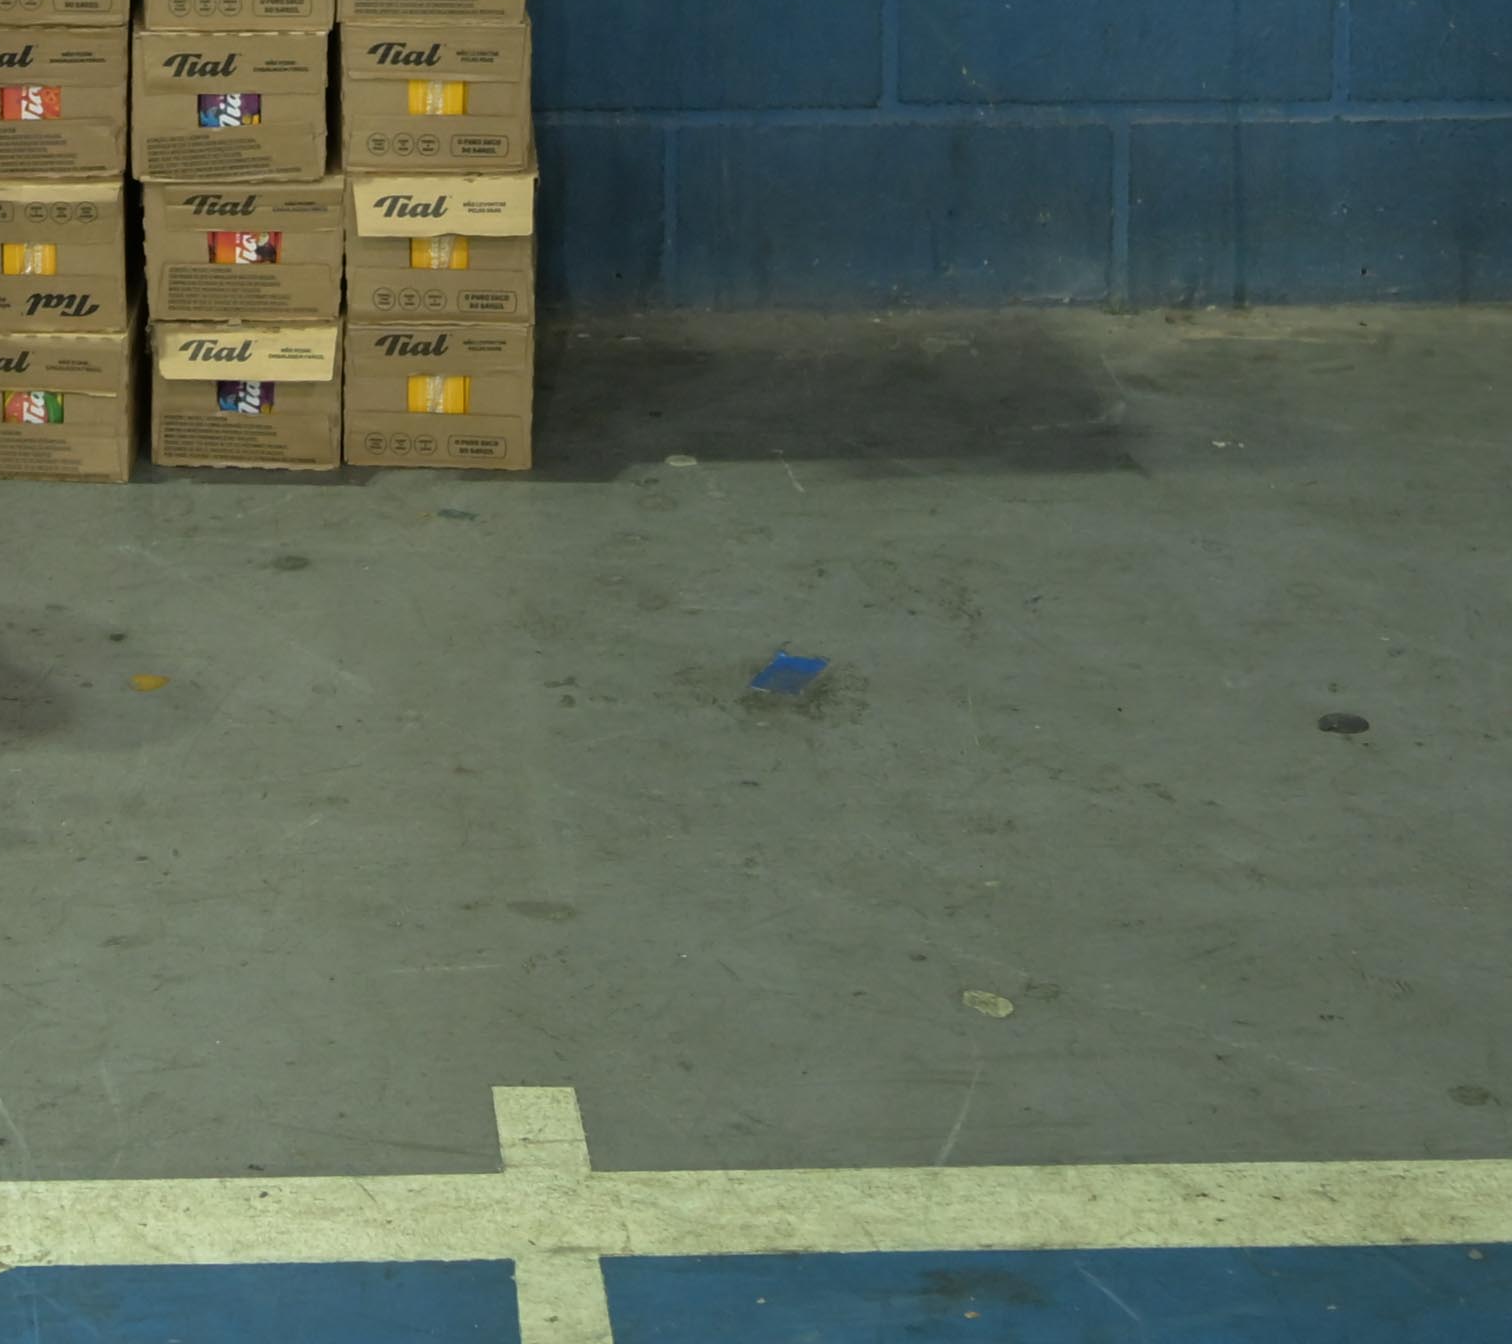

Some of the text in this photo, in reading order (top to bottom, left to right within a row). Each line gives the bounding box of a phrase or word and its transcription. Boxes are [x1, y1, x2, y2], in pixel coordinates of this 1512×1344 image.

[163, 54, 236, 77] Tial
[368, 43, 440, 66] Tial
[374, 196, 447, 218] Tial
[27, 293, 99, 316] Tial
[179, 340, 252, 362] Tial
[375, 334, 448, 356] Tial
